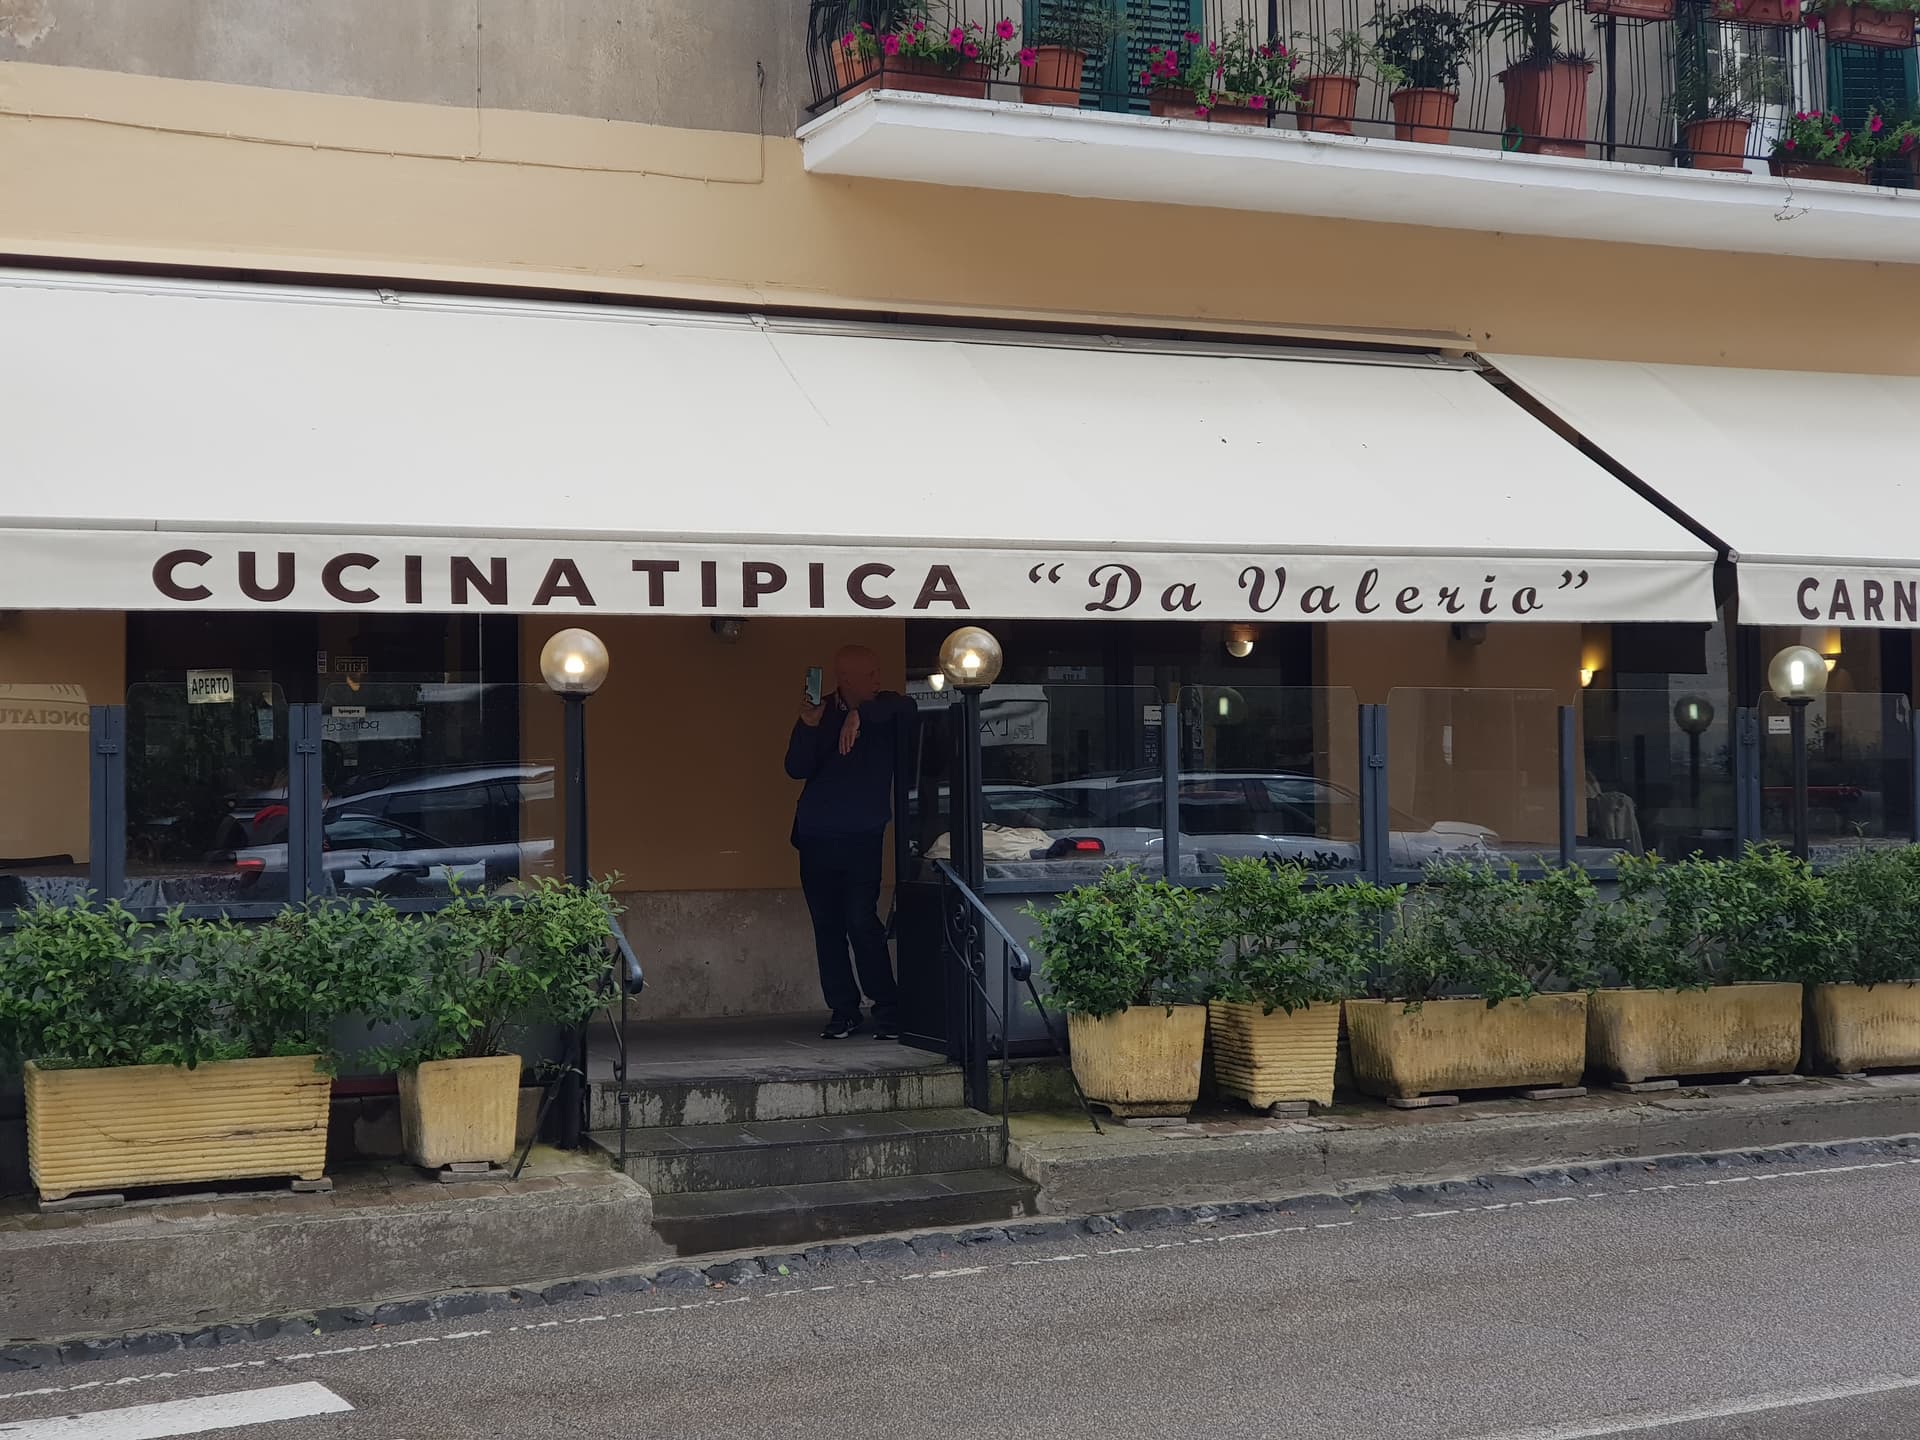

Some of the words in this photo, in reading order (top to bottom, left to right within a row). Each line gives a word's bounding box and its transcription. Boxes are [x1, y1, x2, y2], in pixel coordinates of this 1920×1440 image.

[152, 549, 596, 607] CUCINA
[631, 559, 970, 611] TIPICA
[1796, 576, 1918, 622] CARN
[191, 677, 230, 696] APERTO
